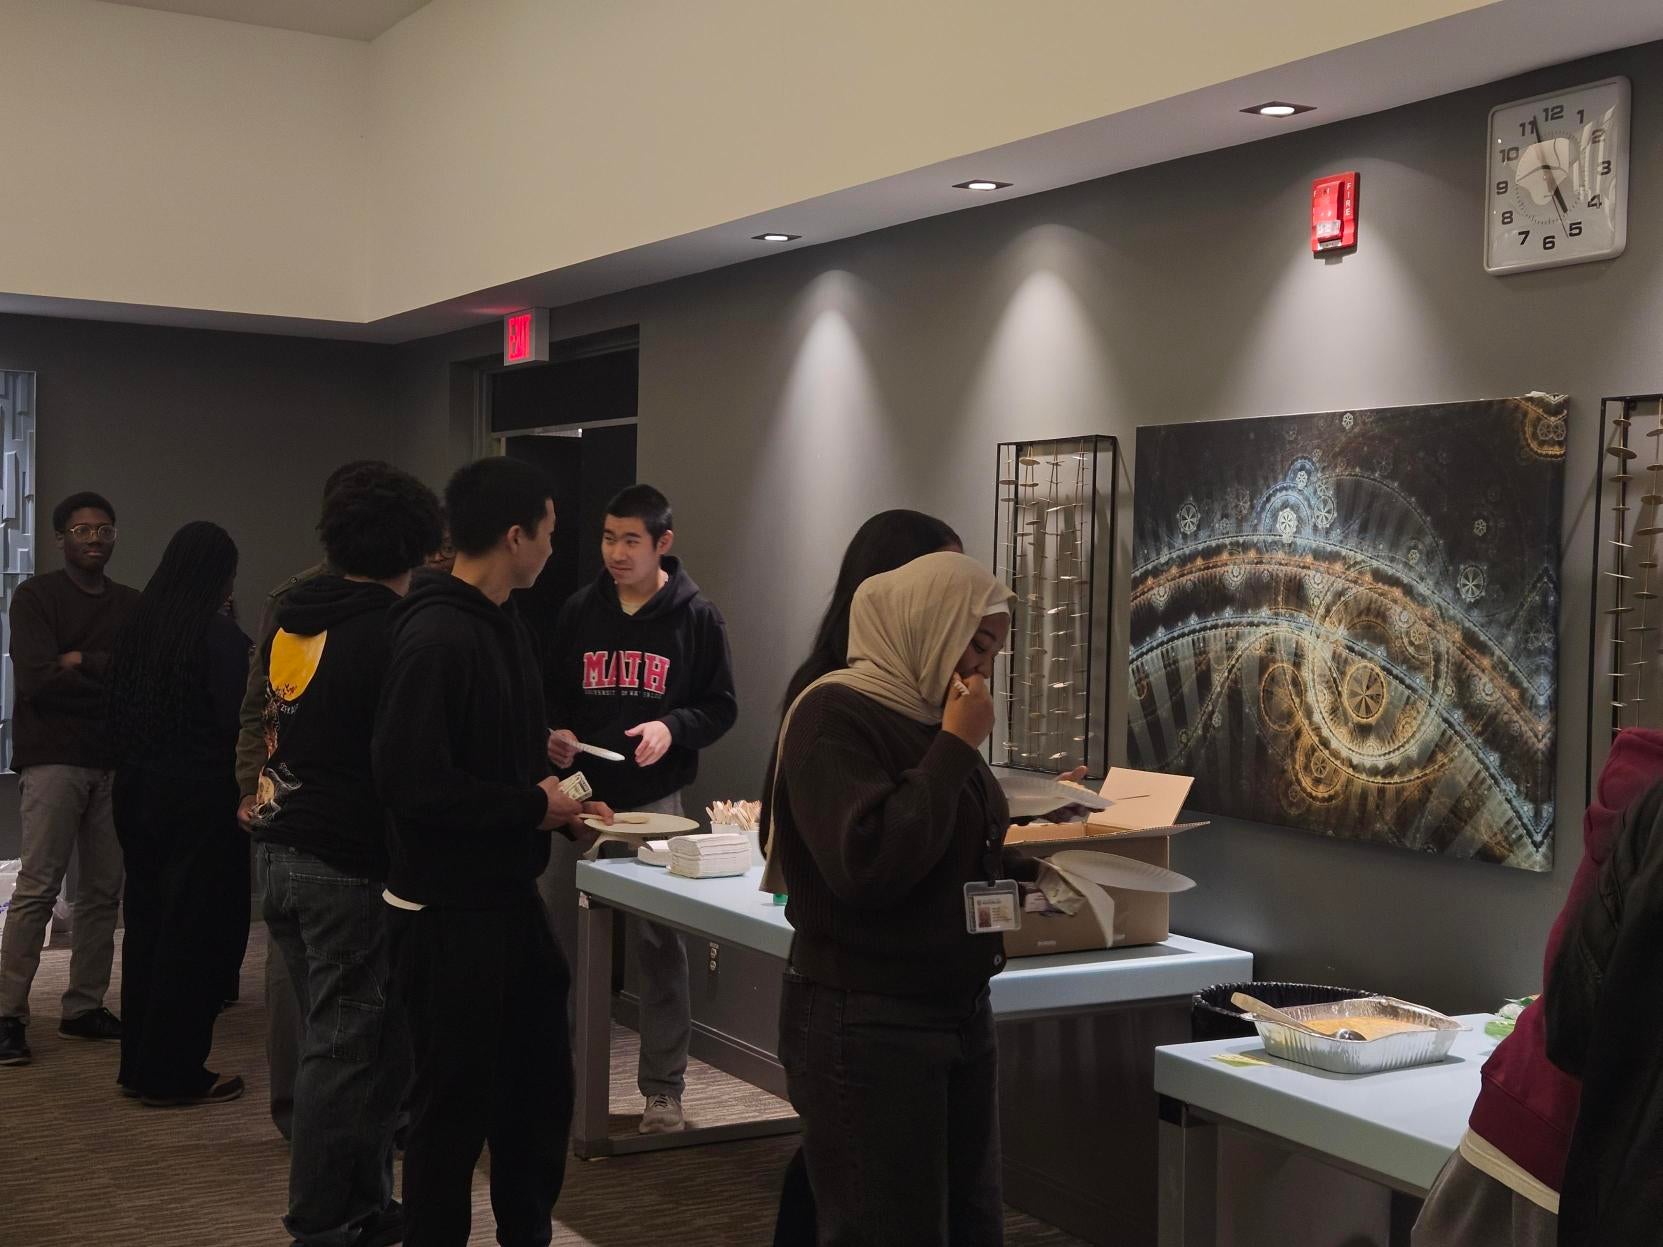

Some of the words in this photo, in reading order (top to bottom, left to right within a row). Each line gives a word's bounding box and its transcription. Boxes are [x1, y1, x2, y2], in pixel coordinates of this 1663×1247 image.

[1542, 104, 1564, 122] 12
[1576, 109, 1585, 124] 1
[1519, 119, 1535, 137] 11
[1591, 128, 1605, 145] 2
[1499, 146, 1520, 163] 10
[1600, 160, 1612, 176] 3
[1496, 180, 1509, 196] 9
[1587, 194, 1603, 209] 4
[1501, 210, 1514, 225] 8
[1568, 221, 1583, 237] 5
[1518, 230, 1530, 246] 7
[1542, 235, 1556, 250] 6
[582, 650, 670, 694] MATH
